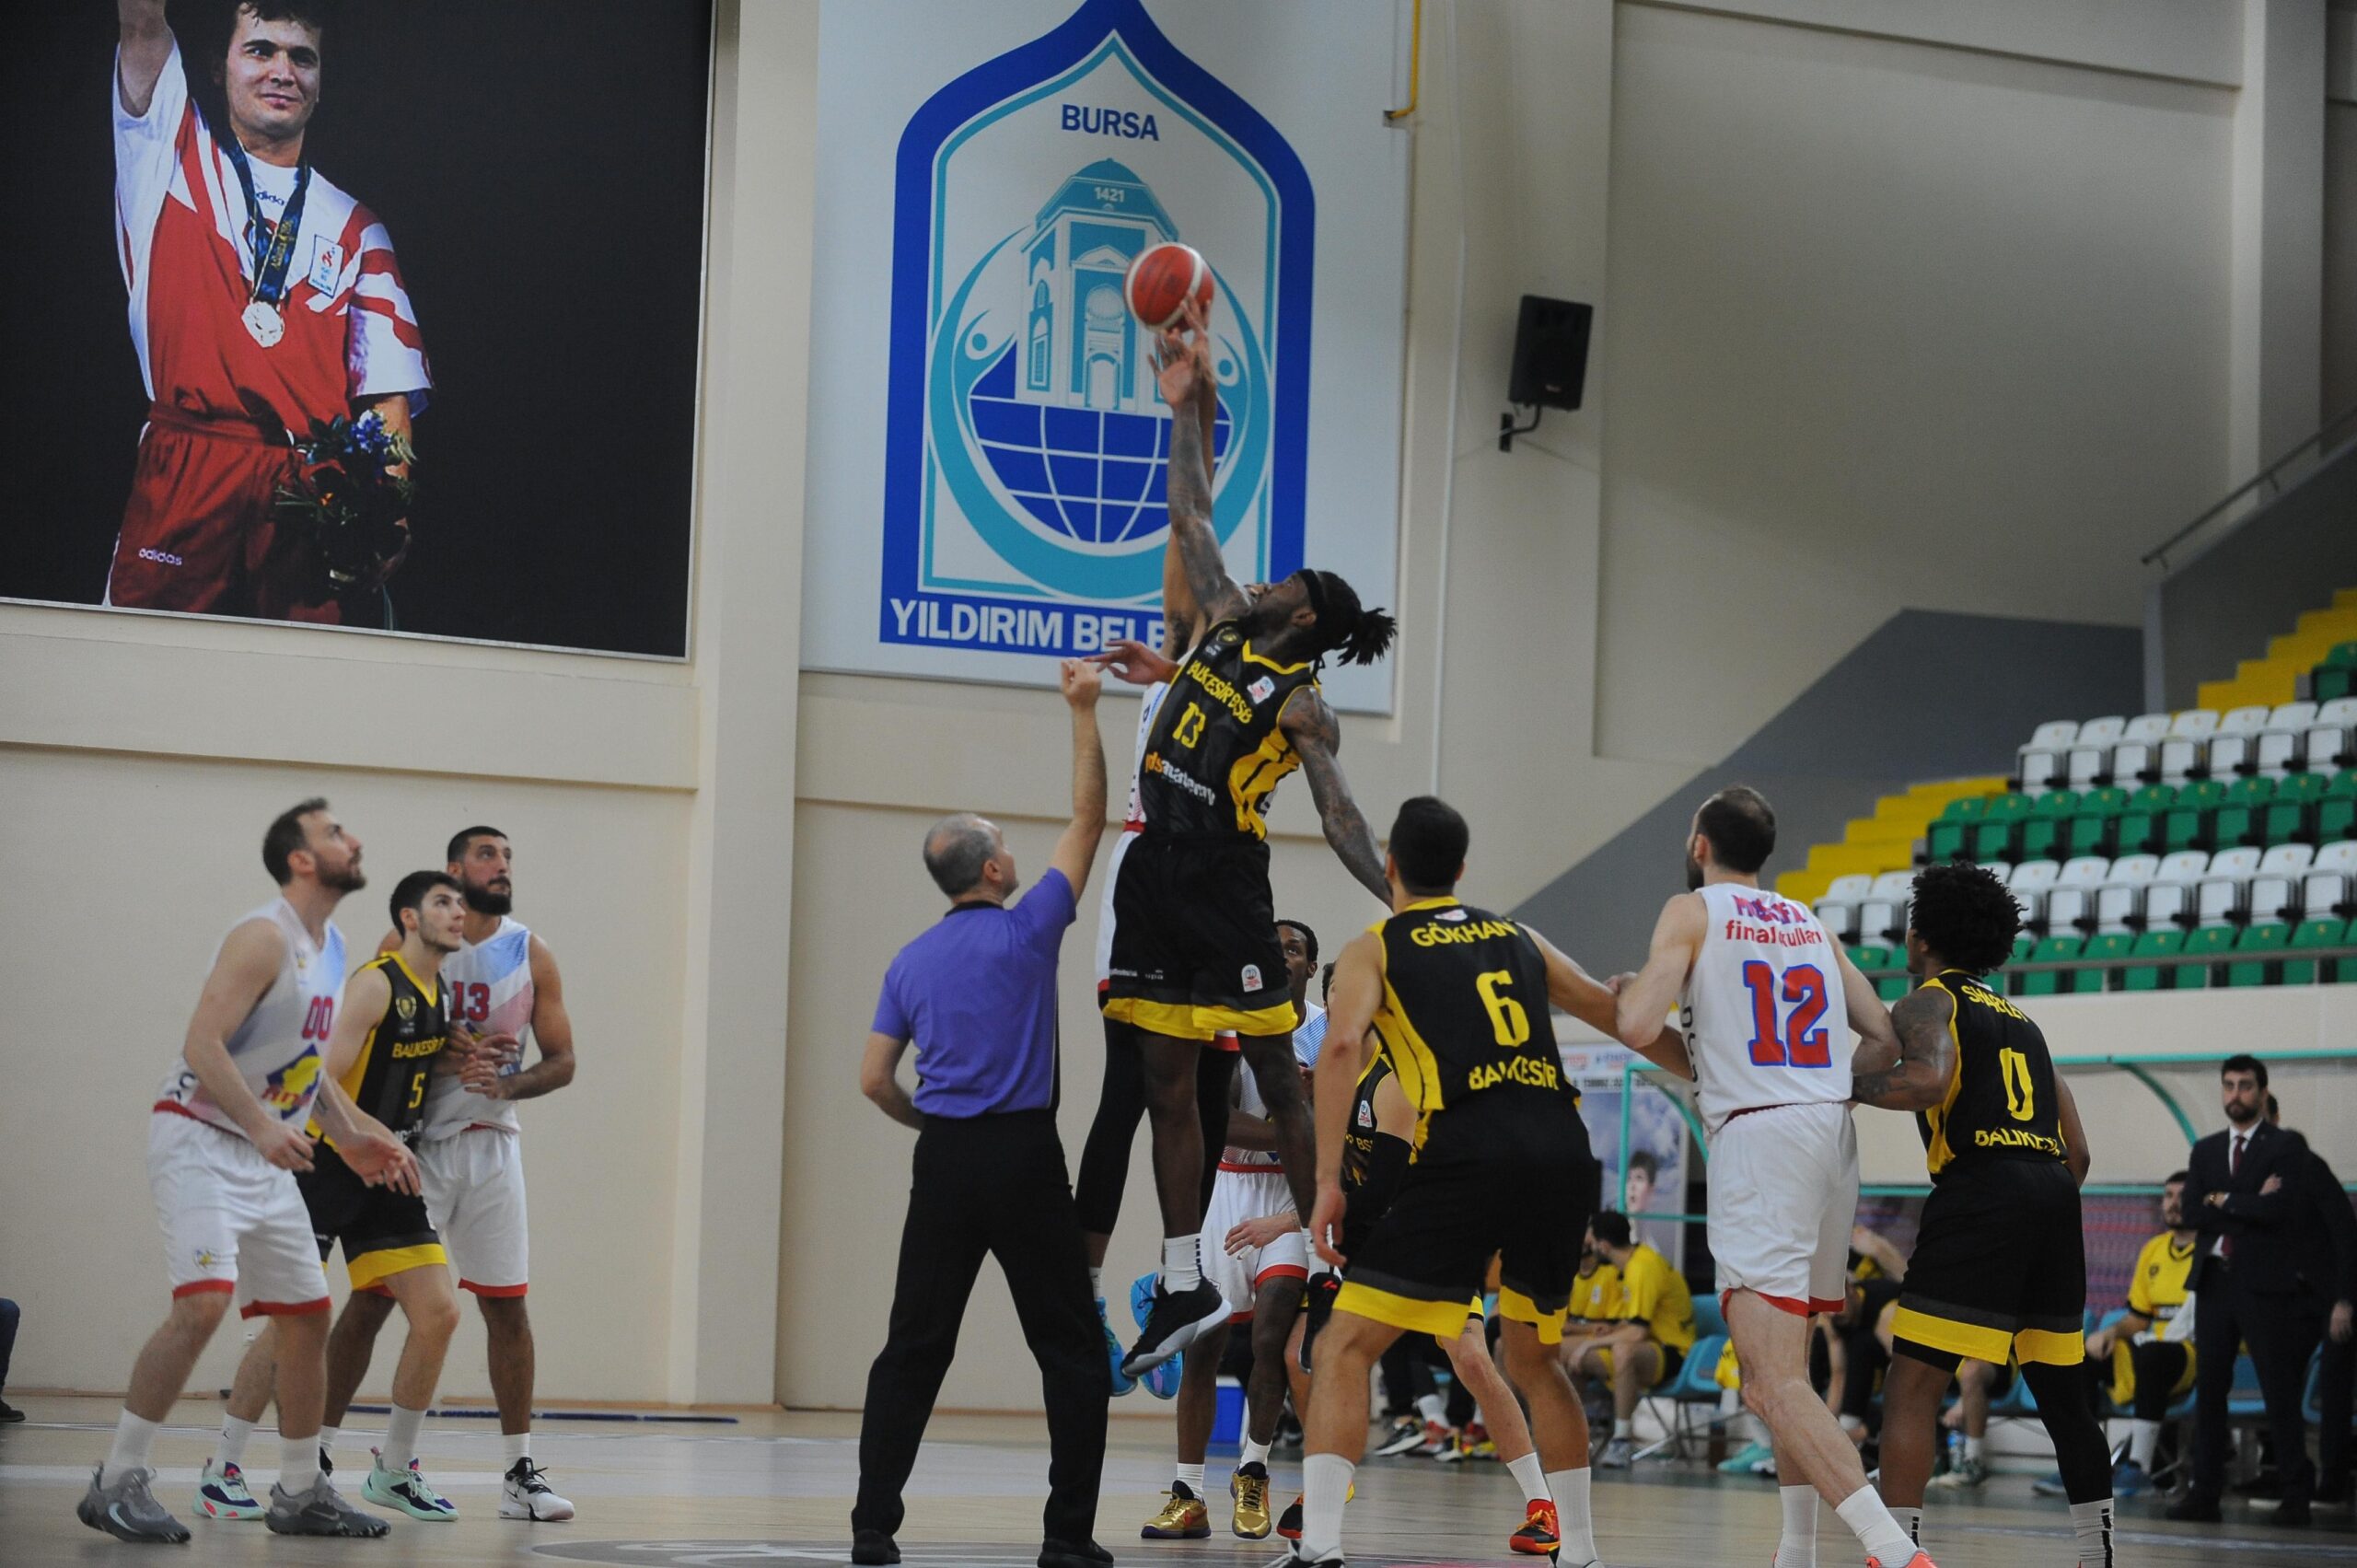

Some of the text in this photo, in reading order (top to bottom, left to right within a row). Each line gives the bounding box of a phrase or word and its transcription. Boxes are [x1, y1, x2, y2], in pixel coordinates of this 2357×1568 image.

[1062, 103, 1159, 141] BURSA
[1094, 186, 1125, 203] 1421
[138, 548, 182, 566] adidas
[890, 598, 1063, 649] YILDIRIM
[1172, 701, 1206, 749] 13
[1410, 918, 1519, 947] GÖKHAN
[1725, 919, 1776, 945] final
[302, 994, 334, 1041] 00
[452, 980, 491, 1023] 13
[1476, 970, 1530, 1048] 6
[1742, 959, 1832, 1069] 12
[408, 1072, 426, 1109] 5
[1999, 1047, 2035, 1121] 0
